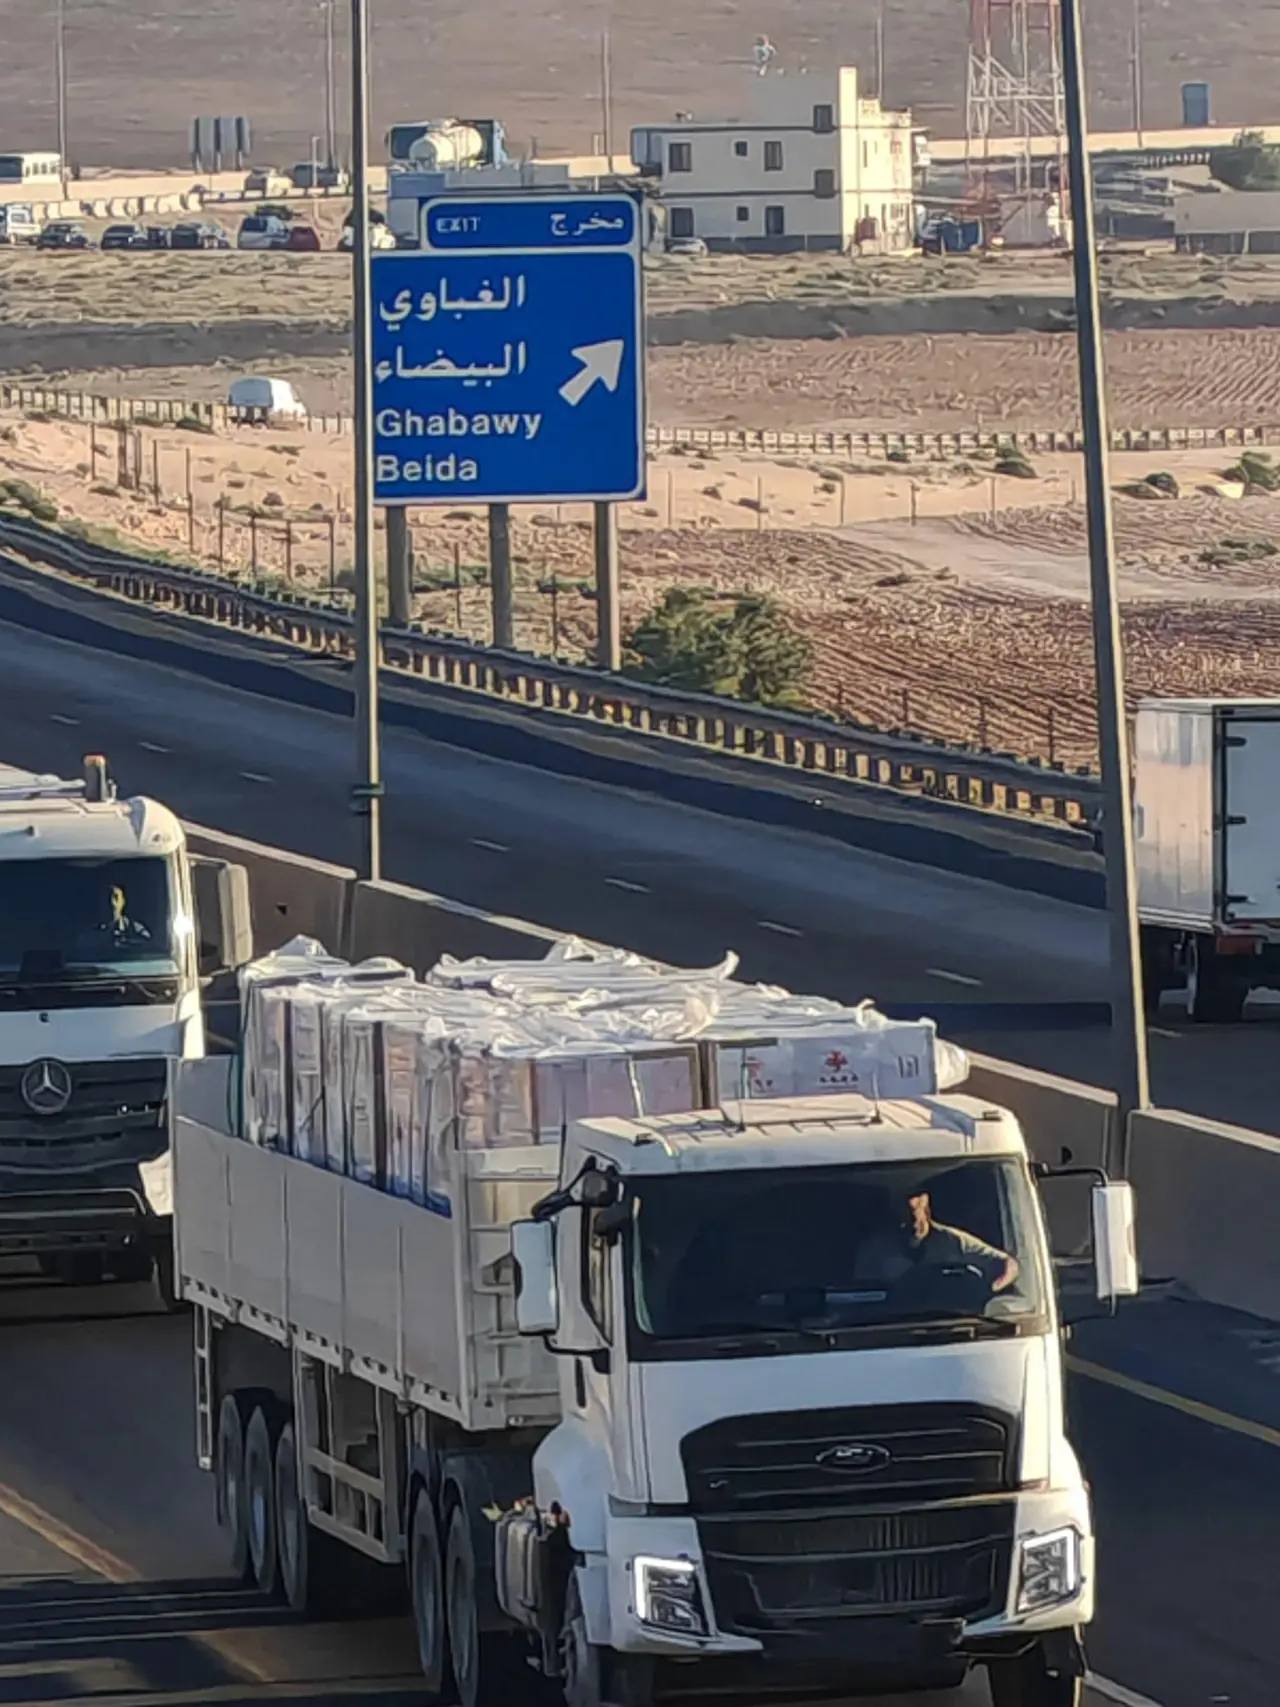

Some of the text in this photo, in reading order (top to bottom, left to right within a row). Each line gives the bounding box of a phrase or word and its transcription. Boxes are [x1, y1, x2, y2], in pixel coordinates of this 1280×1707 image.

[436, 216, 480, 233] EXIT
[550, 211, 625, 236] مخرج
[379, 274, 525, 332] الغباوي
[375, 341, 526, 387] البيضاء
[376, 408, 542, 440] Ghabawy
[376, 454, 477, 482] Beida
